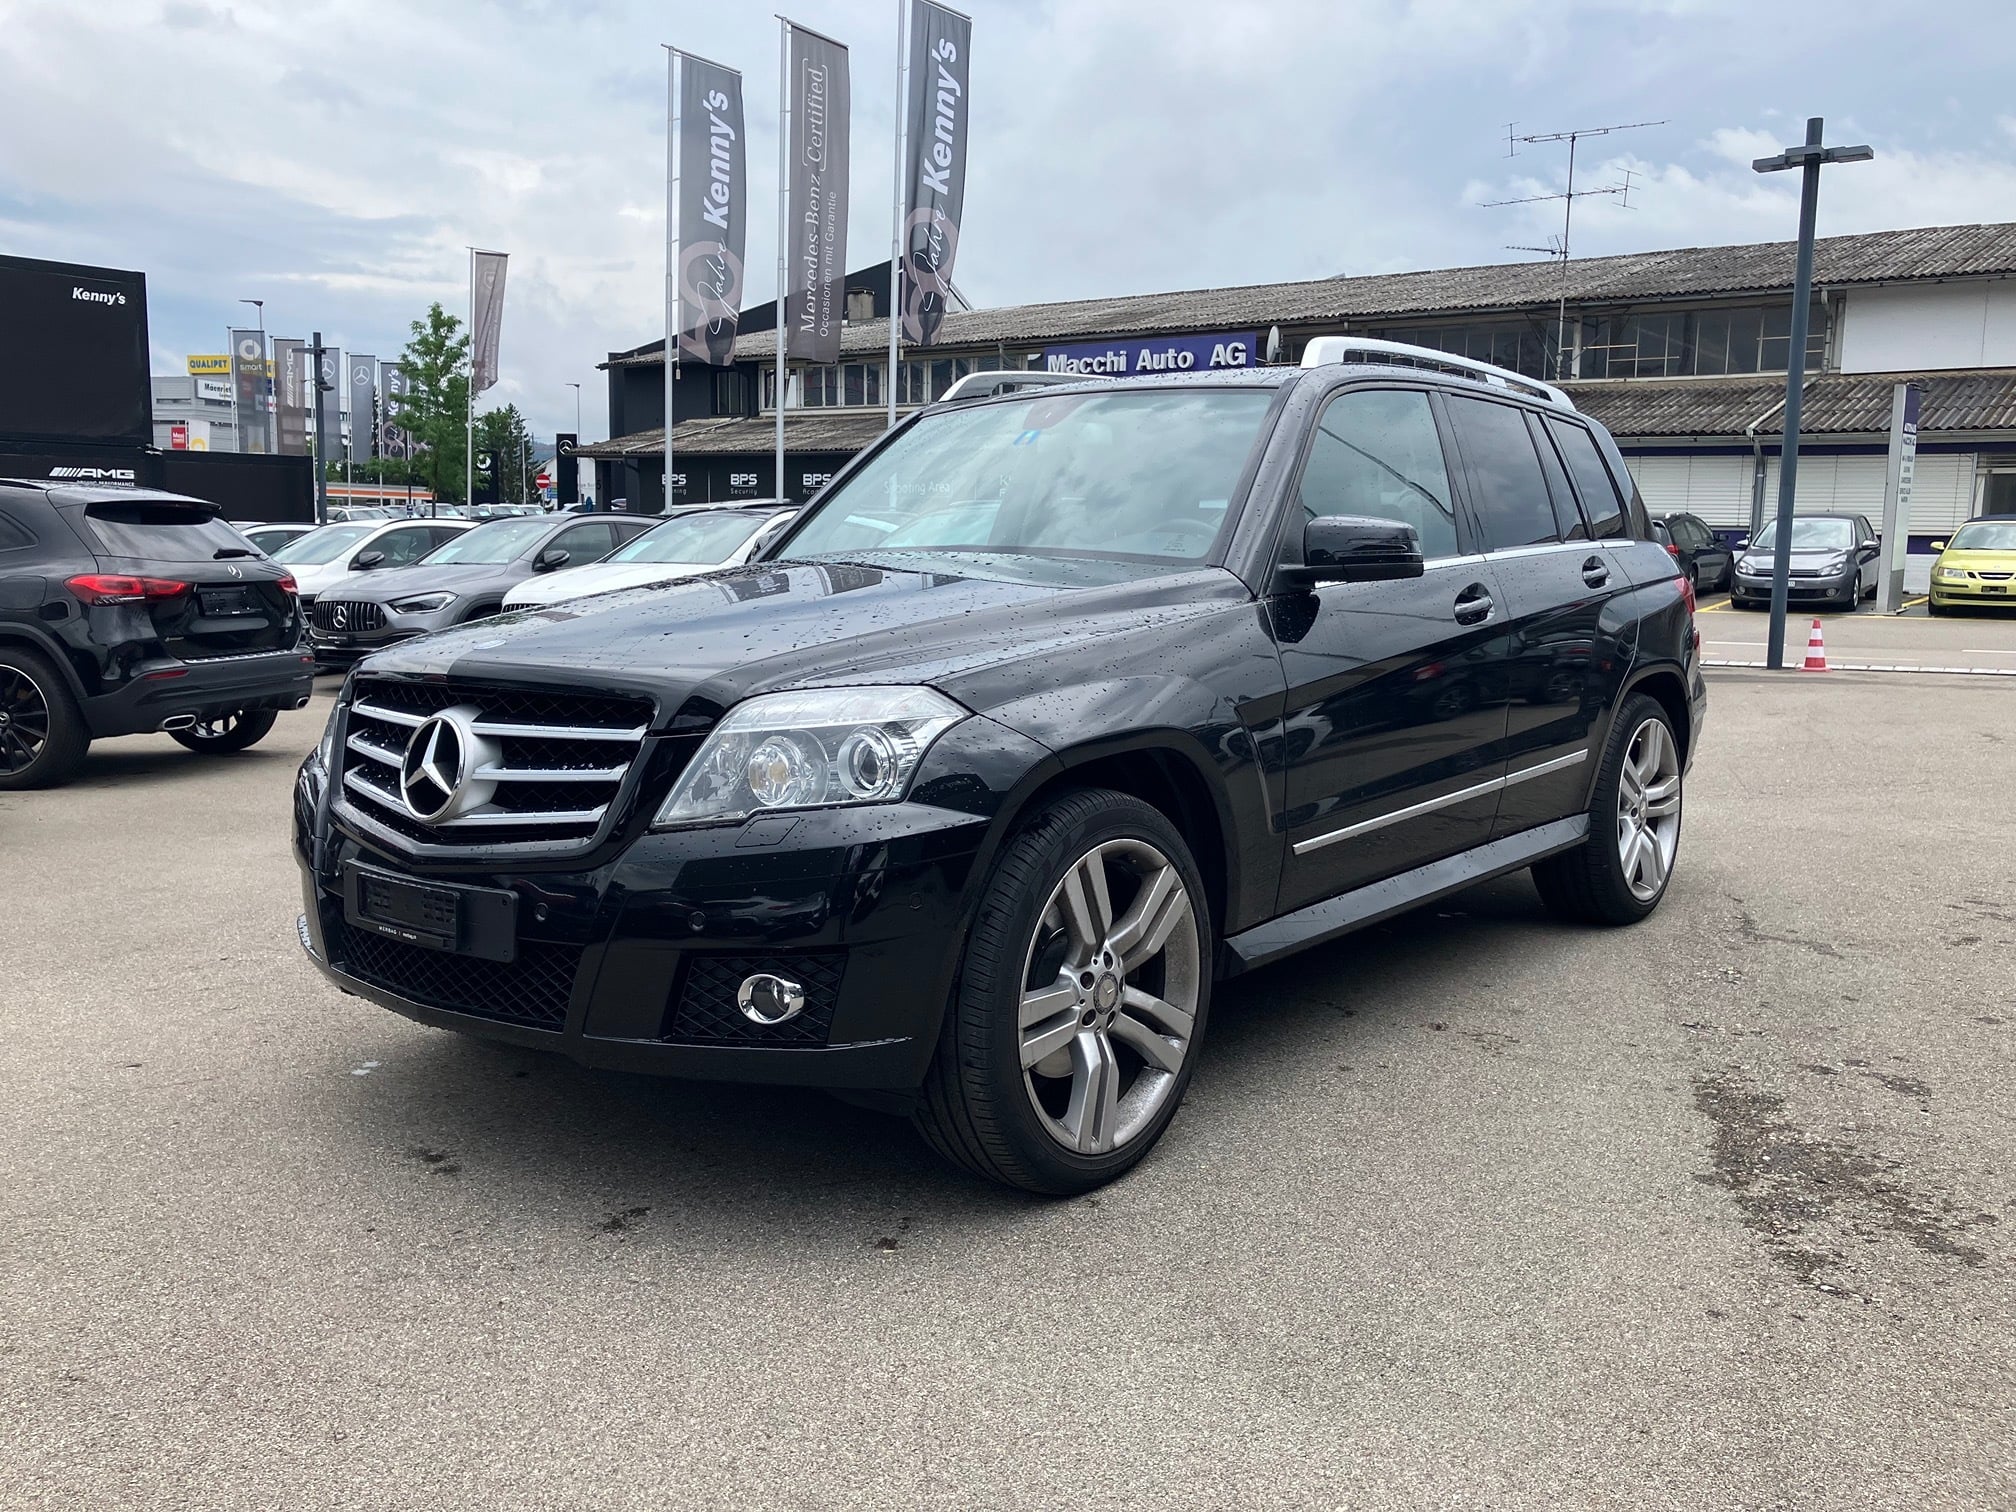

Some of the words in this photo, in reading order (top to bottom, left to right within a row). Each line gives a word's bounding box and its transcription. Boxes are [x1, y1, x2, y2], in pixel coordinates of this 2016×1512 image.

[807, 67, 824, 163] Certified
[923, 38, 960, 195] Kenny's
[703, 89, 735, 230] Kenny's
[825, 191, 837, 242] Garantie
[800, 173, 821, 333] Mercedes-Benz
[825, 249, 833, 268] mit
[913, 203, 948, 312] Jahre
[72, 287, 126, 305] Kenny's
[697, 237, 739, 335] Jahre
[820, 270, 833, 337] Occasionen
[189, 359, 228, 369] QUALIPET
[239, 363, 263, 371] smart
[1047, 351, 1127, 374] Macchi
[1136, 348, 1194, 371] Auto
[1209, 342, 1247, 367] AG
[388, 368, 401, 416] Keny's
[661, 487, 687, 496] Tning
[730, 473, 758, 485] BPS
[730, 487, 758, 496] Security
[802, 473, 832, 486] BPS
[884, 481, 926, 496] Sooting
[928, 480, 951, 493] Area
